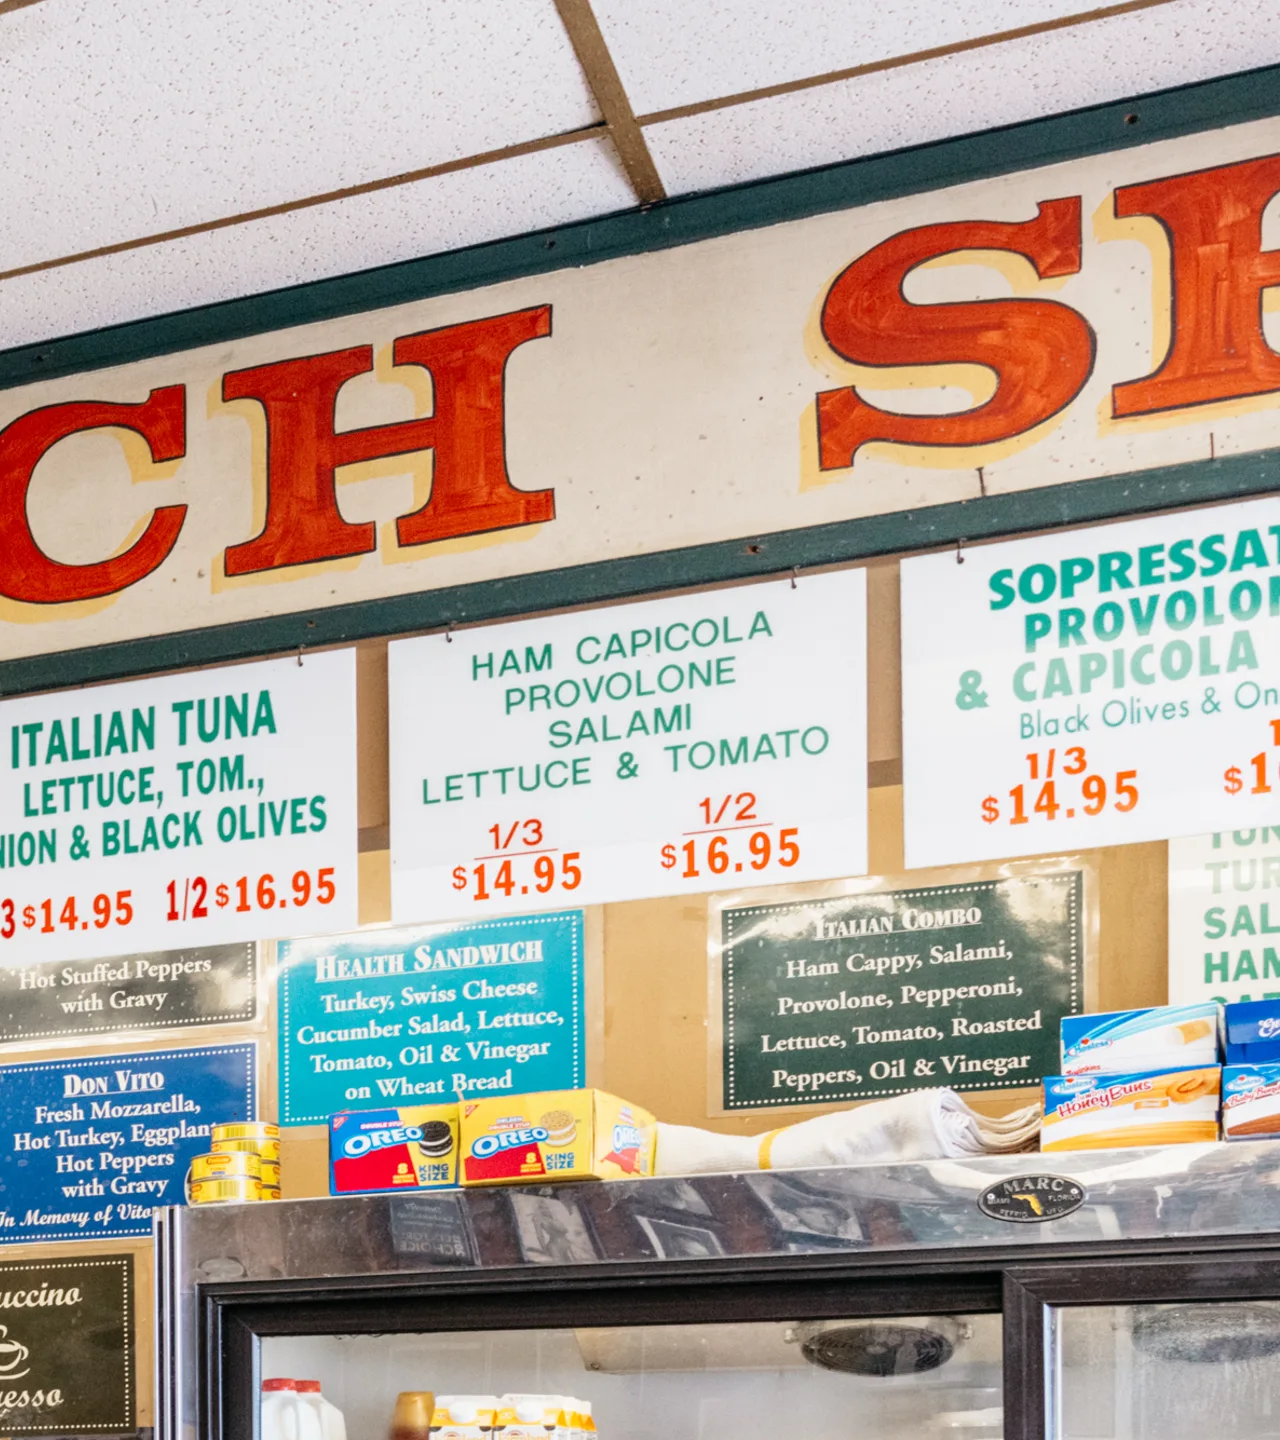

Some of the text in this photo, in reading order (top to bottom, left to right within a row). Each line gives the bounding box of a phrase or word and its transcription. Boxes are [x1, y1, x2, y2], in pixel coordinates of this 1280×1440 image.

[472, 611, 772, 681] HAM CAPICOLA
[955, 630, 1261, 711] & CAPICOLA
[504, 656, 737, 716] PROVOLONE
[12, 690, 276, 769] ITALIAN TUNA
[548, 703, 692, 749] SALAMI
[1020, 687, 1221, 739] Black Olives &
[24, 754, 264, 817] LETTUCE, TOM.,
[423, 726, 829, 804] LETTUCE & TOMATO
[69, 825, 90, 861] &
[101, 802, 203, 855] BLACK
[217, 795, 327, 842] OLIVES
[661, 823, 800, 878] $16.95
[452, 849, 581, 900] $14.95
[786, 940, 1013, 980] Ham Cappy, Salami,
[321, 977, 537, 1015] Turkey, Swiss Cheese
[35, 1097, 201, 1124] Fresh Mozzarella,
[344, 1128, 422, 1154] OREO
[472, 1129, 547, 1155] OREO
[419, 1164, 448, 1173] KING
[420, 1172, 448, 1182] SIZE
